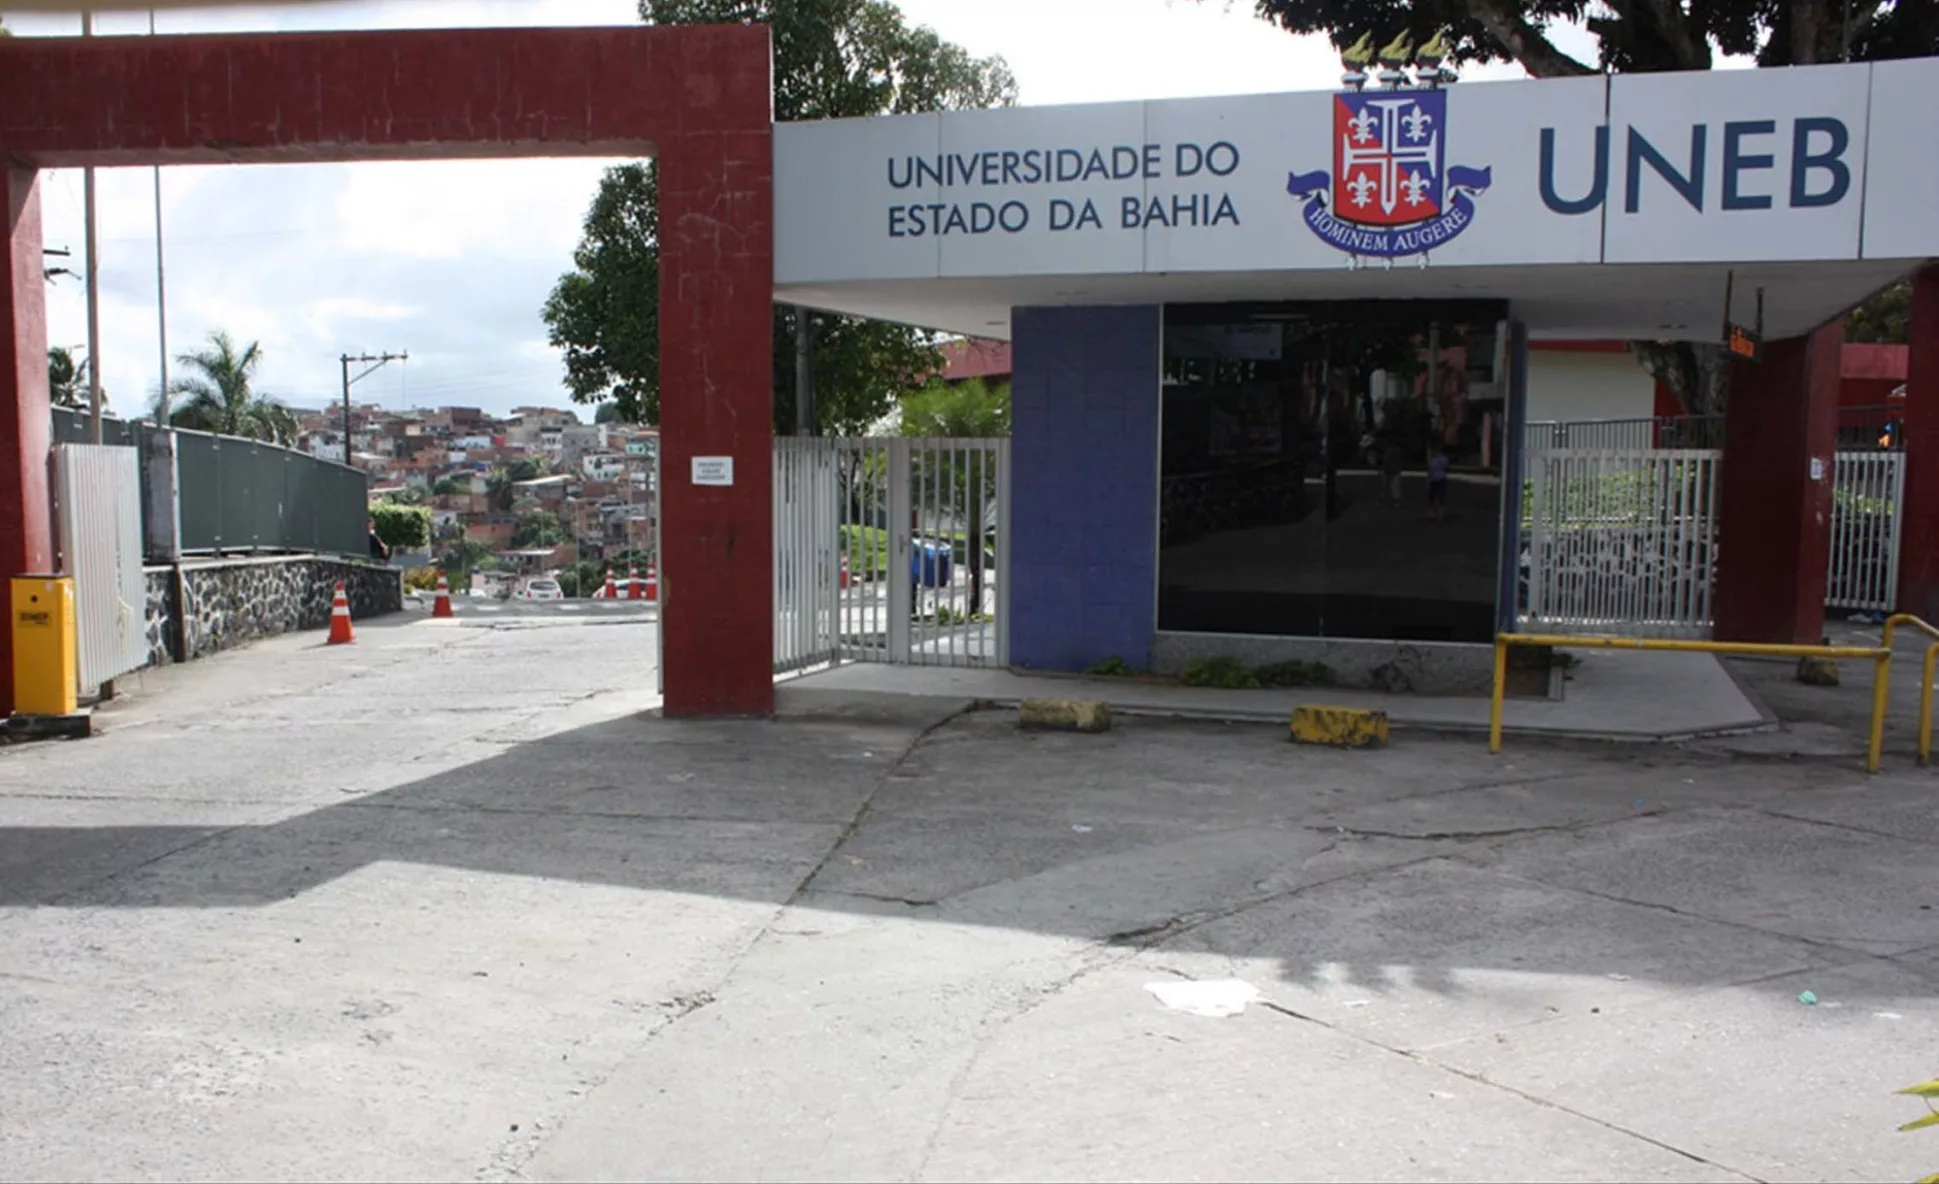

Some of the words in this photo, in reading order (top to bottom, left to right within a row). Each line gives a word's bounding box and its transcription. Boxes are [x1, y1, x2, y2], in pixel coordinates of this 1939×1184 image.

[888, 144, 1161, 189] UNIVERSIDADE
[1175, 141, 1240, 177] DO
[1539, 117, 1851, 215] UNEB
[888, 200, 1029, 237] ESTADO
[1049, 198, 1103, 231] DA
[1121, 193, 1241, 229] BAHIA
[1309, 207, 1388, 250] HOMINEM
[1393, 207, 1468, 250] AUGERE
